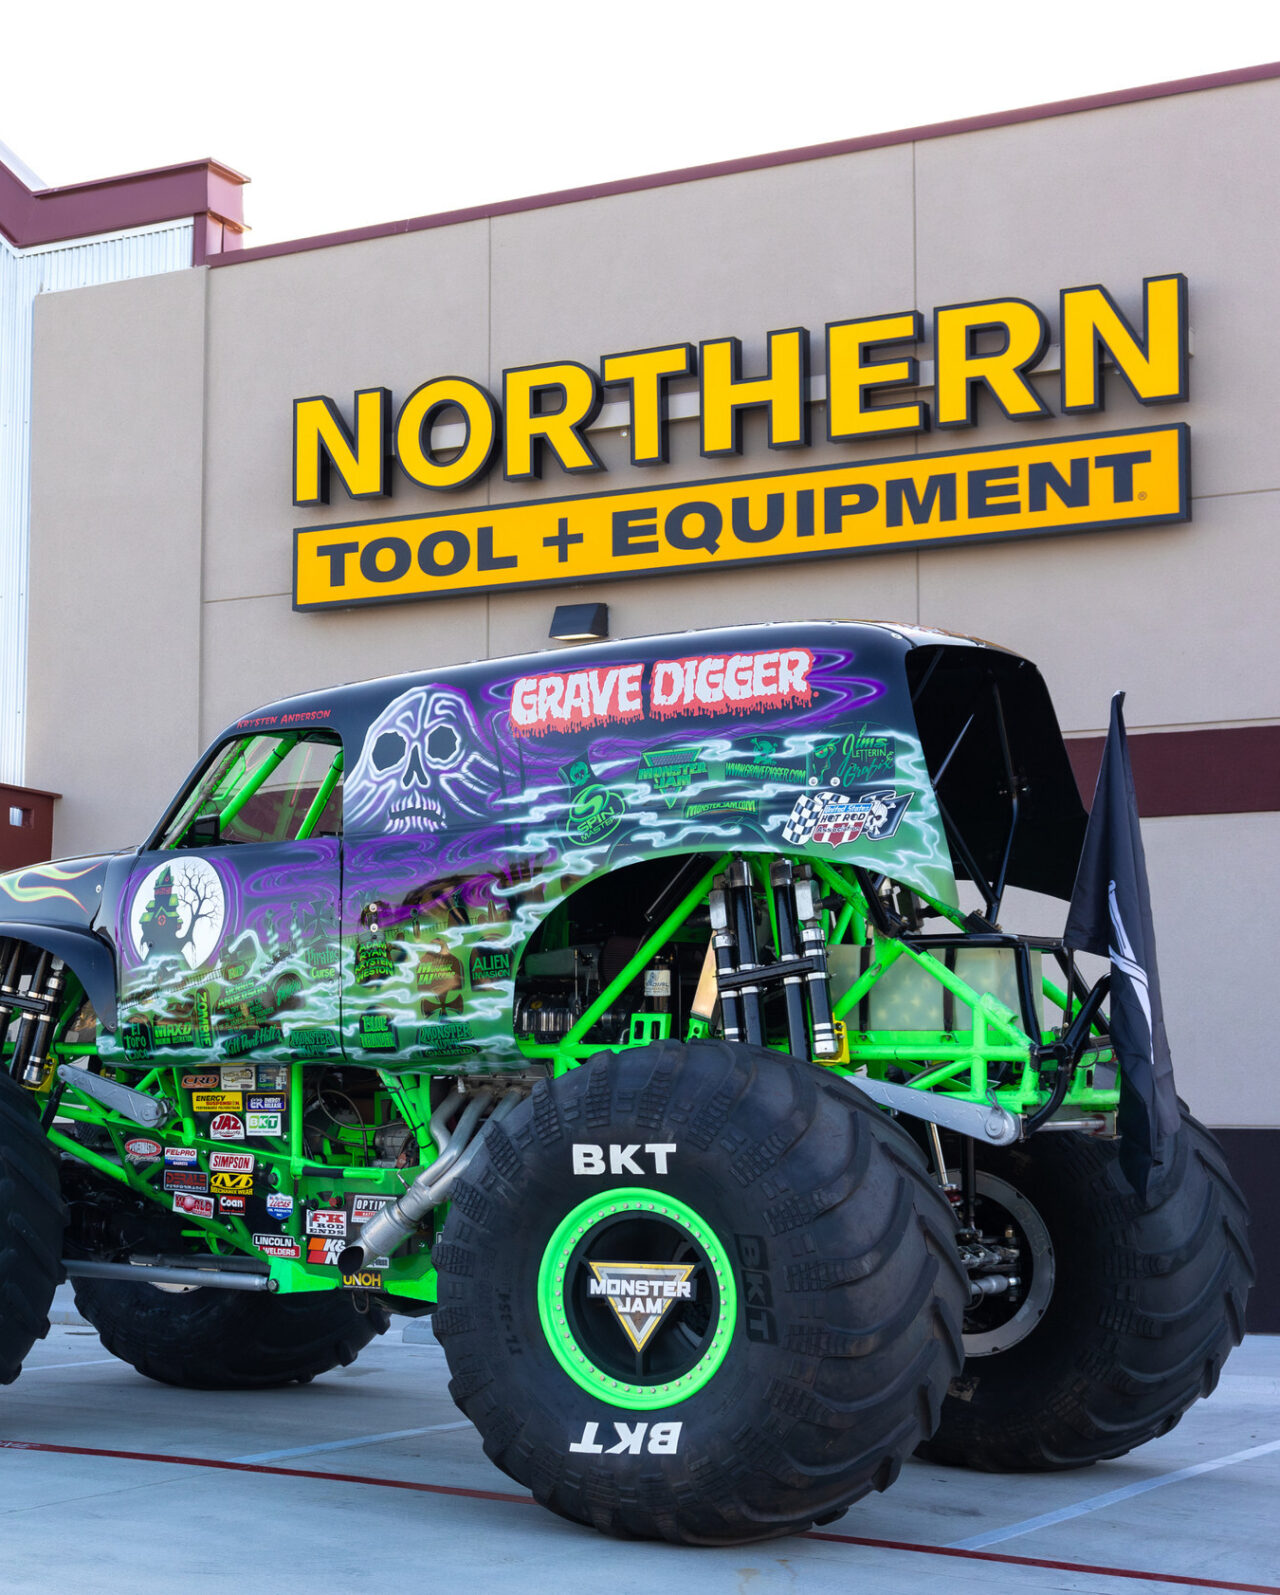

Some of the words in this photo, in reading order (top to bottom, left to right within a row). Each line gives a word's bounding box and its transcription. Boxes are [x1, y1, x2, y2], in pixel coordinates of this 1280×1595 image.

[292, 273, 1188, 507] NORTHERN
[316, 528, 518, 587] TOOL
[510, 663, 645, 730] GRAVE
[651, 649, 812, 711] DIGGER
[236, 716, 278, 729] KRYSTEN
[280, 709, 331, 725] ANDERSON
[638, 761, 708, 781] MONSTER
[654, 774, 691, 789] JAM
[577, 806, 615, 833] SPIN
[821, 814, 841, 823] HOT
[842, 812, 867, 822] ROD
[581, 814, 618, 842] MASTER
[360, 950, 387, 962] RYAN
[472, 954, 509, 971] ALIEN
[311, 967, 336, 979] Curse
[472, 969, 510, 980] INVASION
[195, 991, 212, 1047] ZOMBIE
[291, 1030, 333, 1046] MONSTER
[421, 1023, 471, 1041] MONSTER
[183, 1076, 217, 1084] CRD
[212, 1115, 241, 1130] JAZ
[248, 1115, 279, 1129] BKT
[165, 1149, 196, 1157] FEL-PRO
[571, 1143, 677, 1175] BKT
[213, 1155, 250, 1169] SIMPSON
[166, 1172, 206, 1187] DERALE
[220, 1196, 243, 1208] Coan
[269, 1200, 292, 1208] LUCAS
[355, 1199, 386, 1211] OPTIM
[312, 1213, 344, 1223] FK
[255, 1236, 292, 1247] LINCOLN
[263, 1245, 296, 1257] WELDERS
[343, 1273, 381, 1287] UNOH
[589, 1277, 692, 1299] MONSTER
[618, 1297, 664, 1315] JAM
[569, 1422, 683, 1455] BKT
